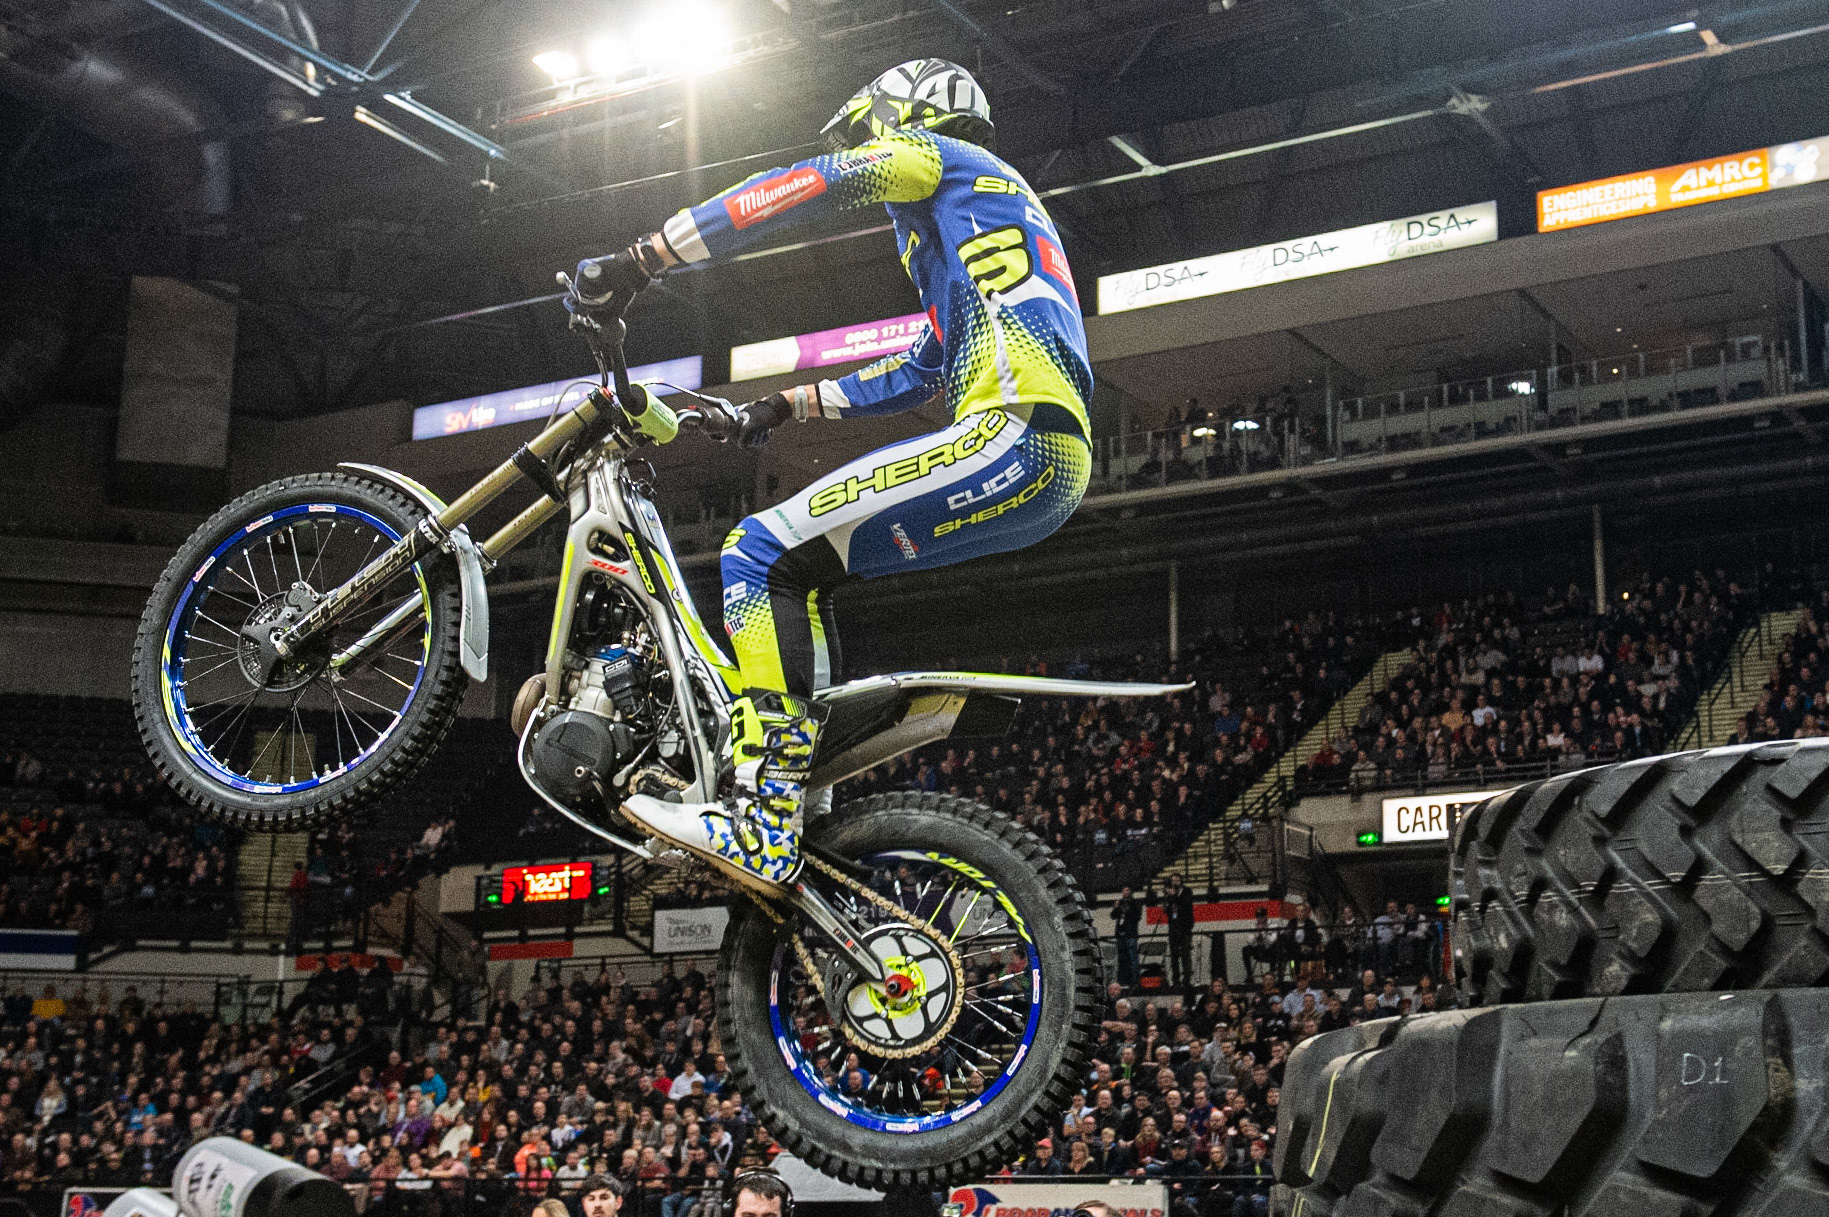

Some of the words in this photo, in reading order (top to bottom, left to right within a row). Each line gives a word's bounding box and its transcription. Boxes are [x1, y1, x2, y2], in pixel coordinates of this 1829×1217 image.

[733, 173, 818, 216] Milwaukee
[1670, 156, 1763, 193] AMRC
[1543, 176, 1657, 214] ENGINEERING
[1543, 197, 1657, 227] APPRENTICESHIPS
[956, 224, 1034, 301] 6
[1406, 238, 1444, 254] arena
[808, 408, 1009, 518] SHERCO
[933, 465, 1056, 539] SHERCO
[946, 461, 1026, 510] CLICE
[586, 558, 629, 576] 300
[624, 531, 657, 595] SHERCO
[604, 658, 628, 673] CDI
